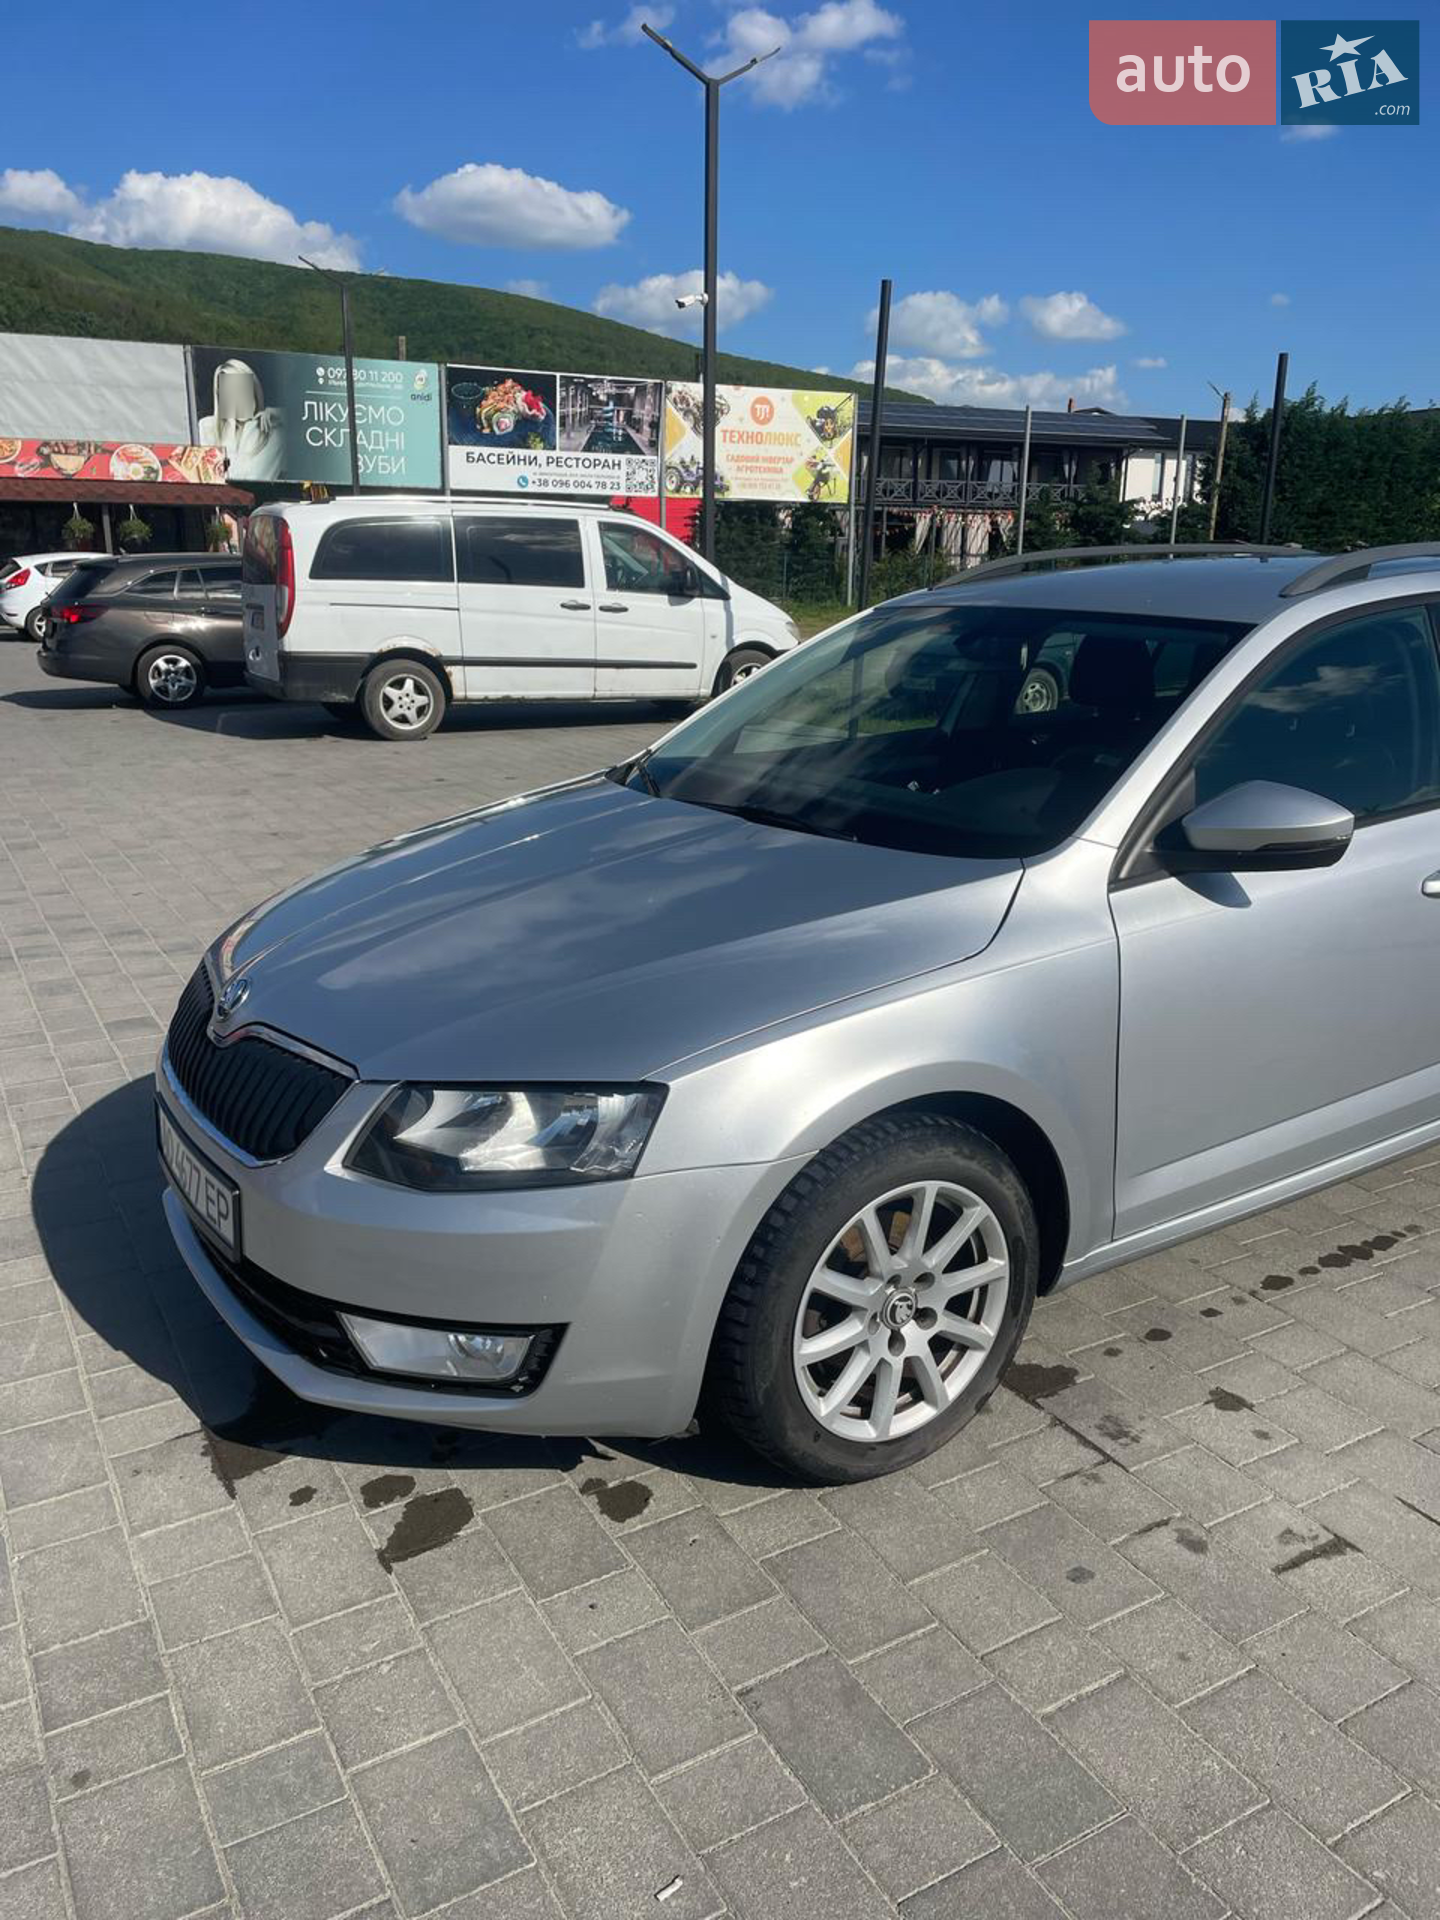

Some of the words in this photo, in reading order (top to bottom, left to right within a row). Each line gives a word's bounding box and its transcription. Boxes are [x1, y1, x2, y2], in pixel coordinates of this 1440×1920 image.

[380, 371, 403, 383] 200
[302, 401, 405, 426] ЛІКУЄМО
[306, 427, 405, 452] СКЛАДНІ
[720, 429, 802, 447] ТЕХНОЛЮКС
[465, 451, 542, 468] БАСЕЙНИ,
[546, 456, 622, 471] РЕСТОРАН
[531, 478, 549, 488] +38
[551, 479, 571, 488] 096
[572, 480, 593, 489] 004
[594, 481, 608, 490] 78
[609, 482, 621, 490] 23
